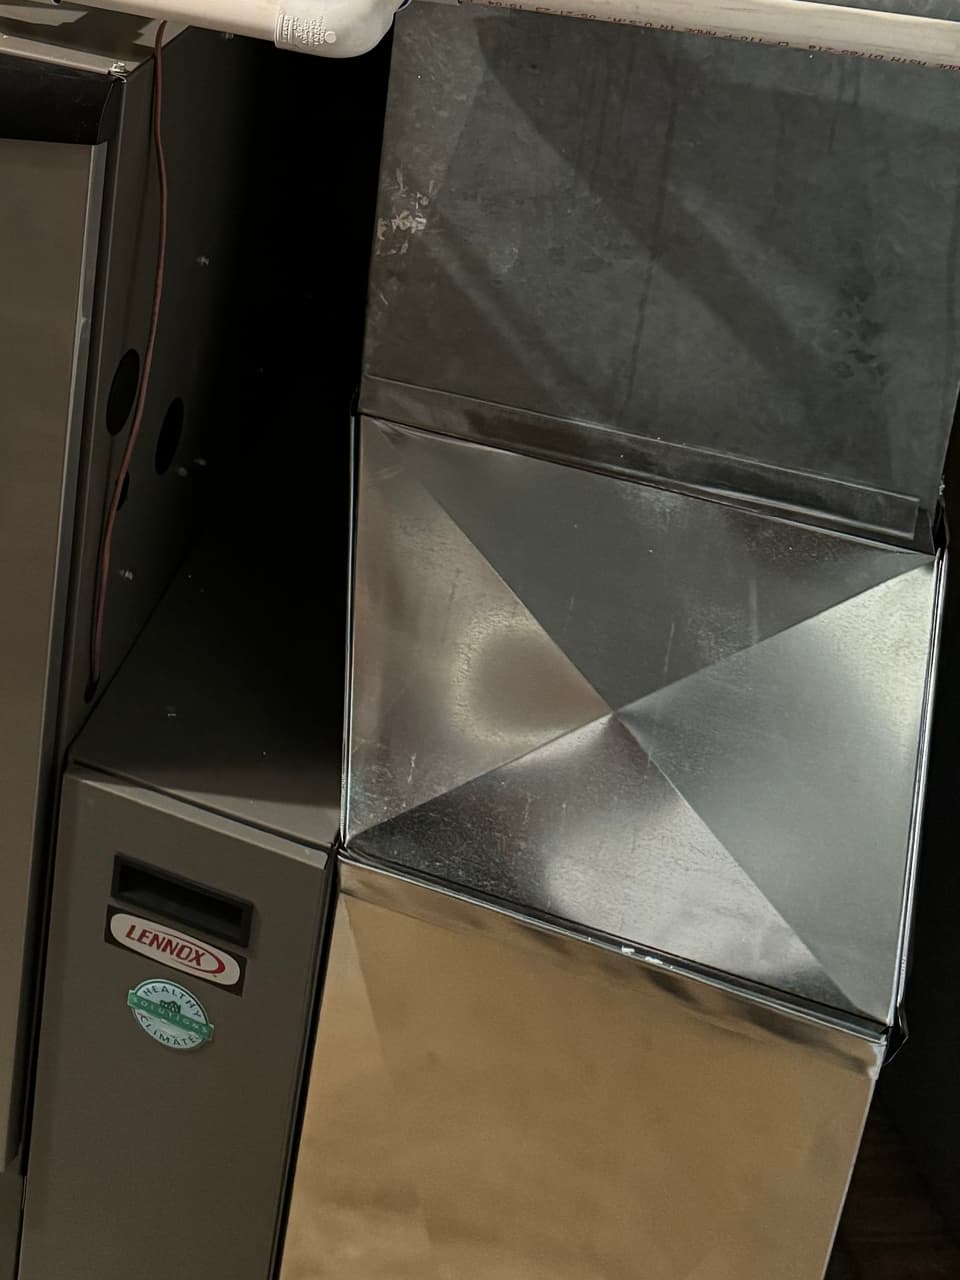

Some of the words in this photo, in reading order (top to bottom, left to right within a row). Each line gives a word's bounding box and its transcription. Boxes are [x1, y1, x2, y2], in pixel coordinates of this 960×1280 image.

[125, 924, 206, 967] LENNOX
[142, 984, 202, 1019] HEALTHY
[140, 1014, 200, 1047] CLIMATE
